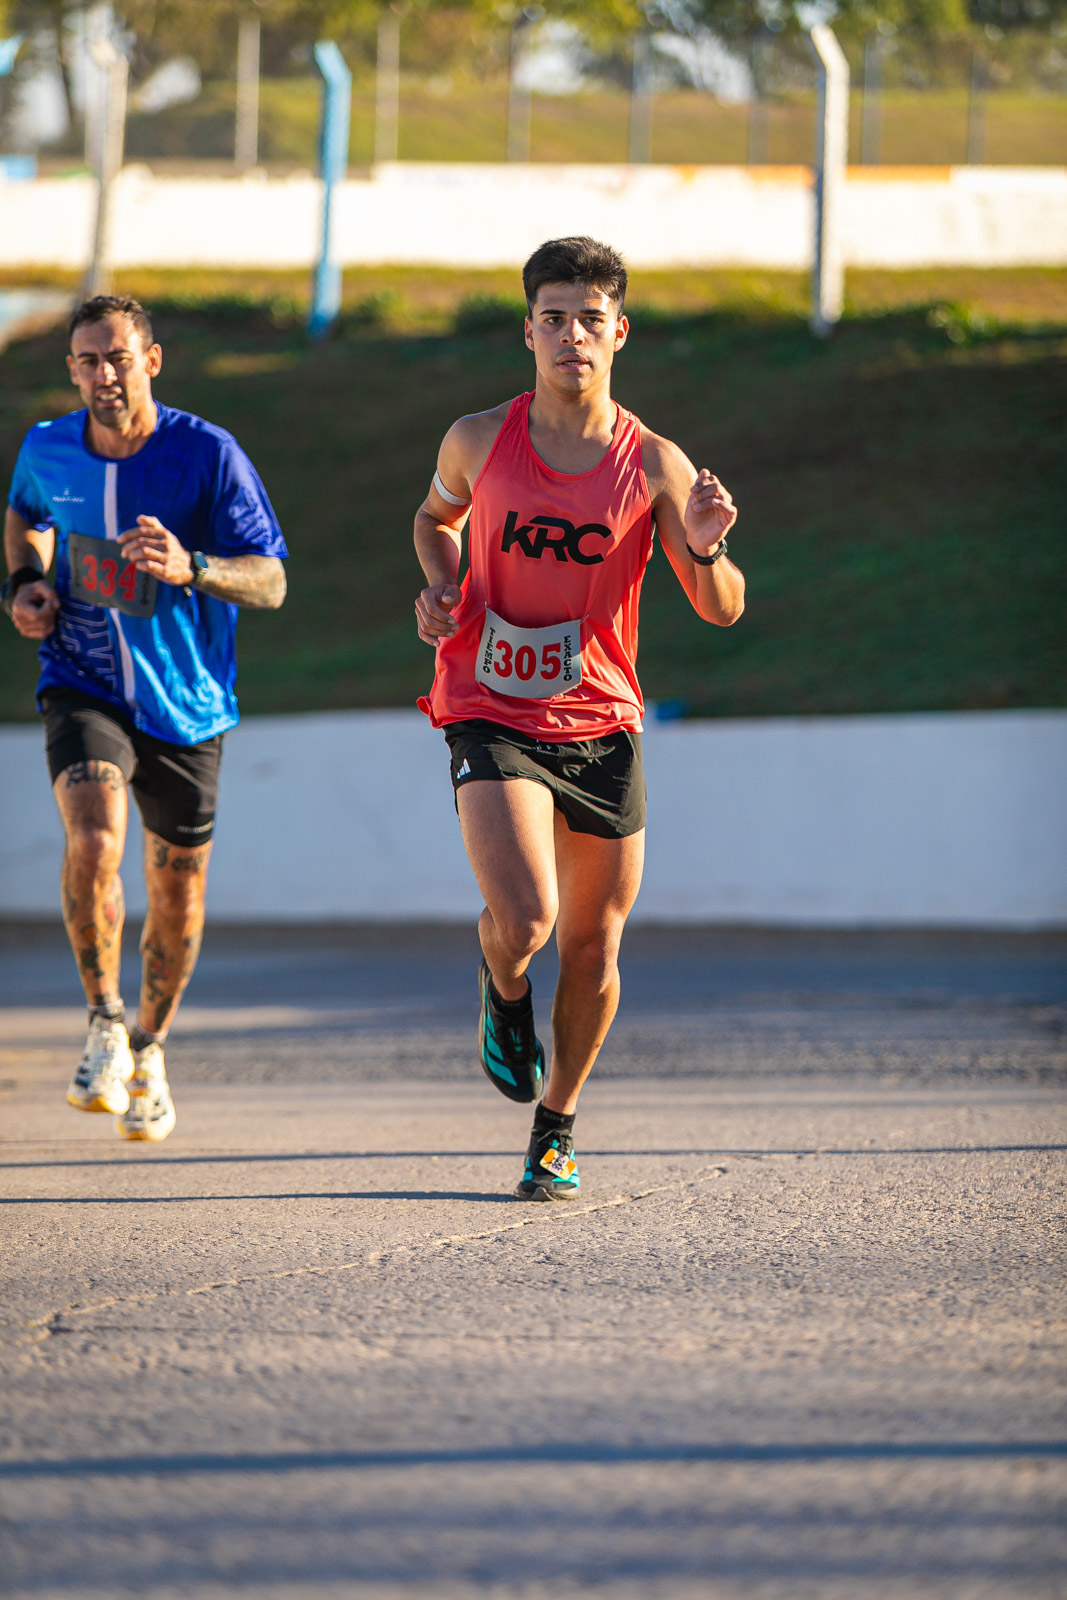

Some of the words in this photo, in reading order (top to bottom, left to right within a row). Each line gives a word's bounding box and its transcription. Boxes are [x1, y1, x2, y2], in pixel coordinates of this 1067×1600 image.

[82, 554, 137, 601] 334
[482, 627, 496, 674] TIEMPO
[494, 639, 562, 681] 305
[563, 635, 573, 681] EXACTO
